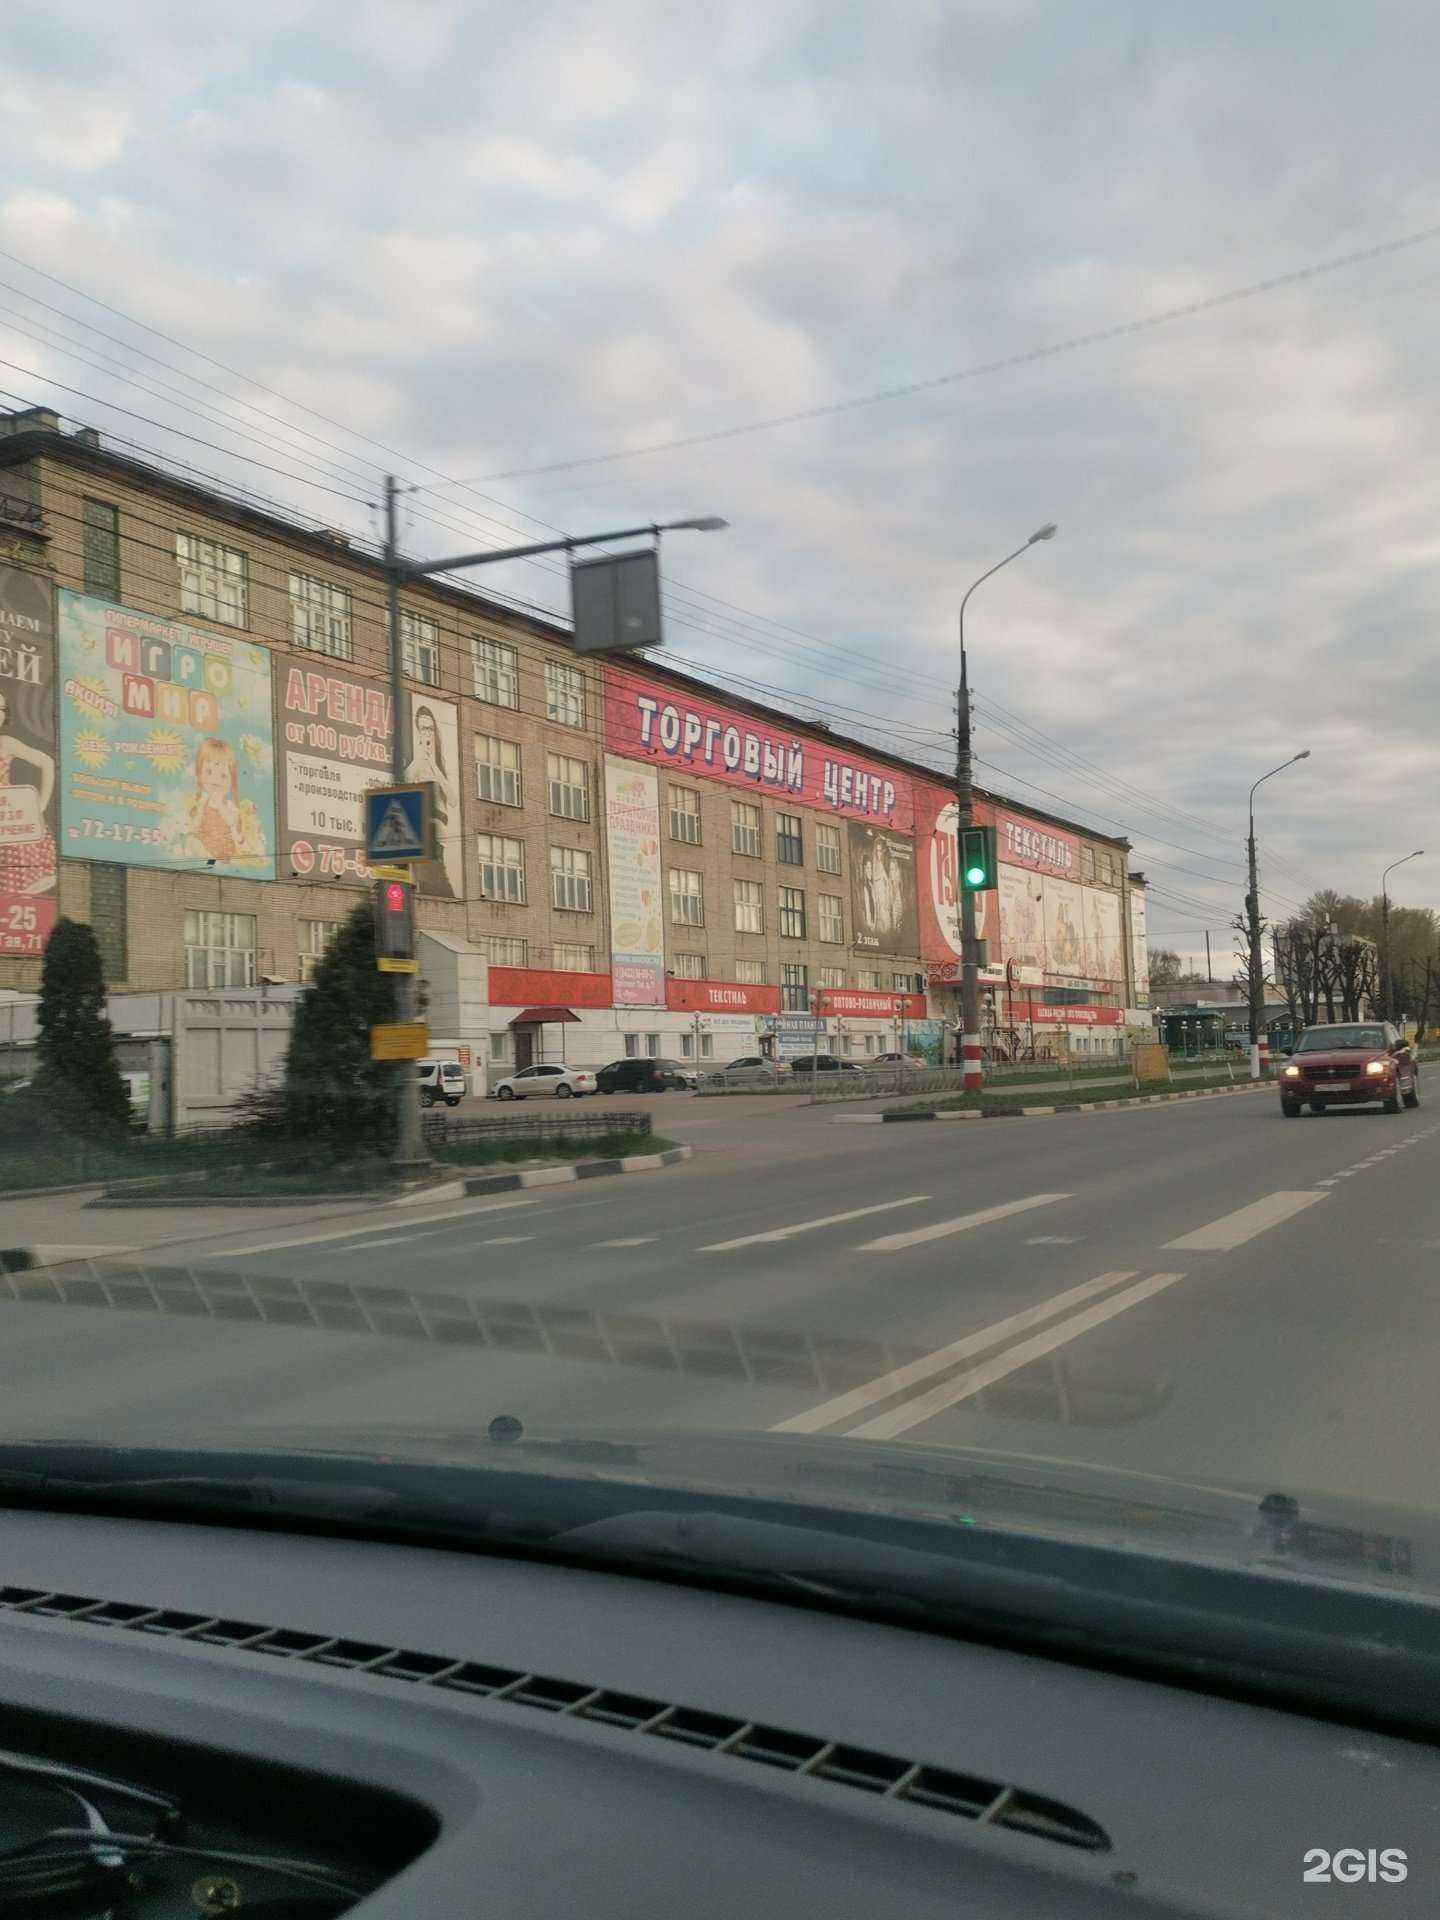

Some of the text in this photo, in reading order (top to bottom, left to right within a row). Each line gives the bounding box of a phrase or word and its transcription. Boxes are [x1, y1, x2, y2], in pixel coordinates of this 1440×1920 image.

[109, 632, 232, 692] ИГРО
[125, 676, 214, 727] МИР
[307, 724, 336, 750] 100
[637, 695, 896, 815] ТОРГОВЫЙ ЦЕНТР
[310, 811, 326, 828] 10
[1005, 821, 1073, 869] ТЕКСТИЛЬ
[708, 989, 747, 1004] ТЕКСТИЛЬ
